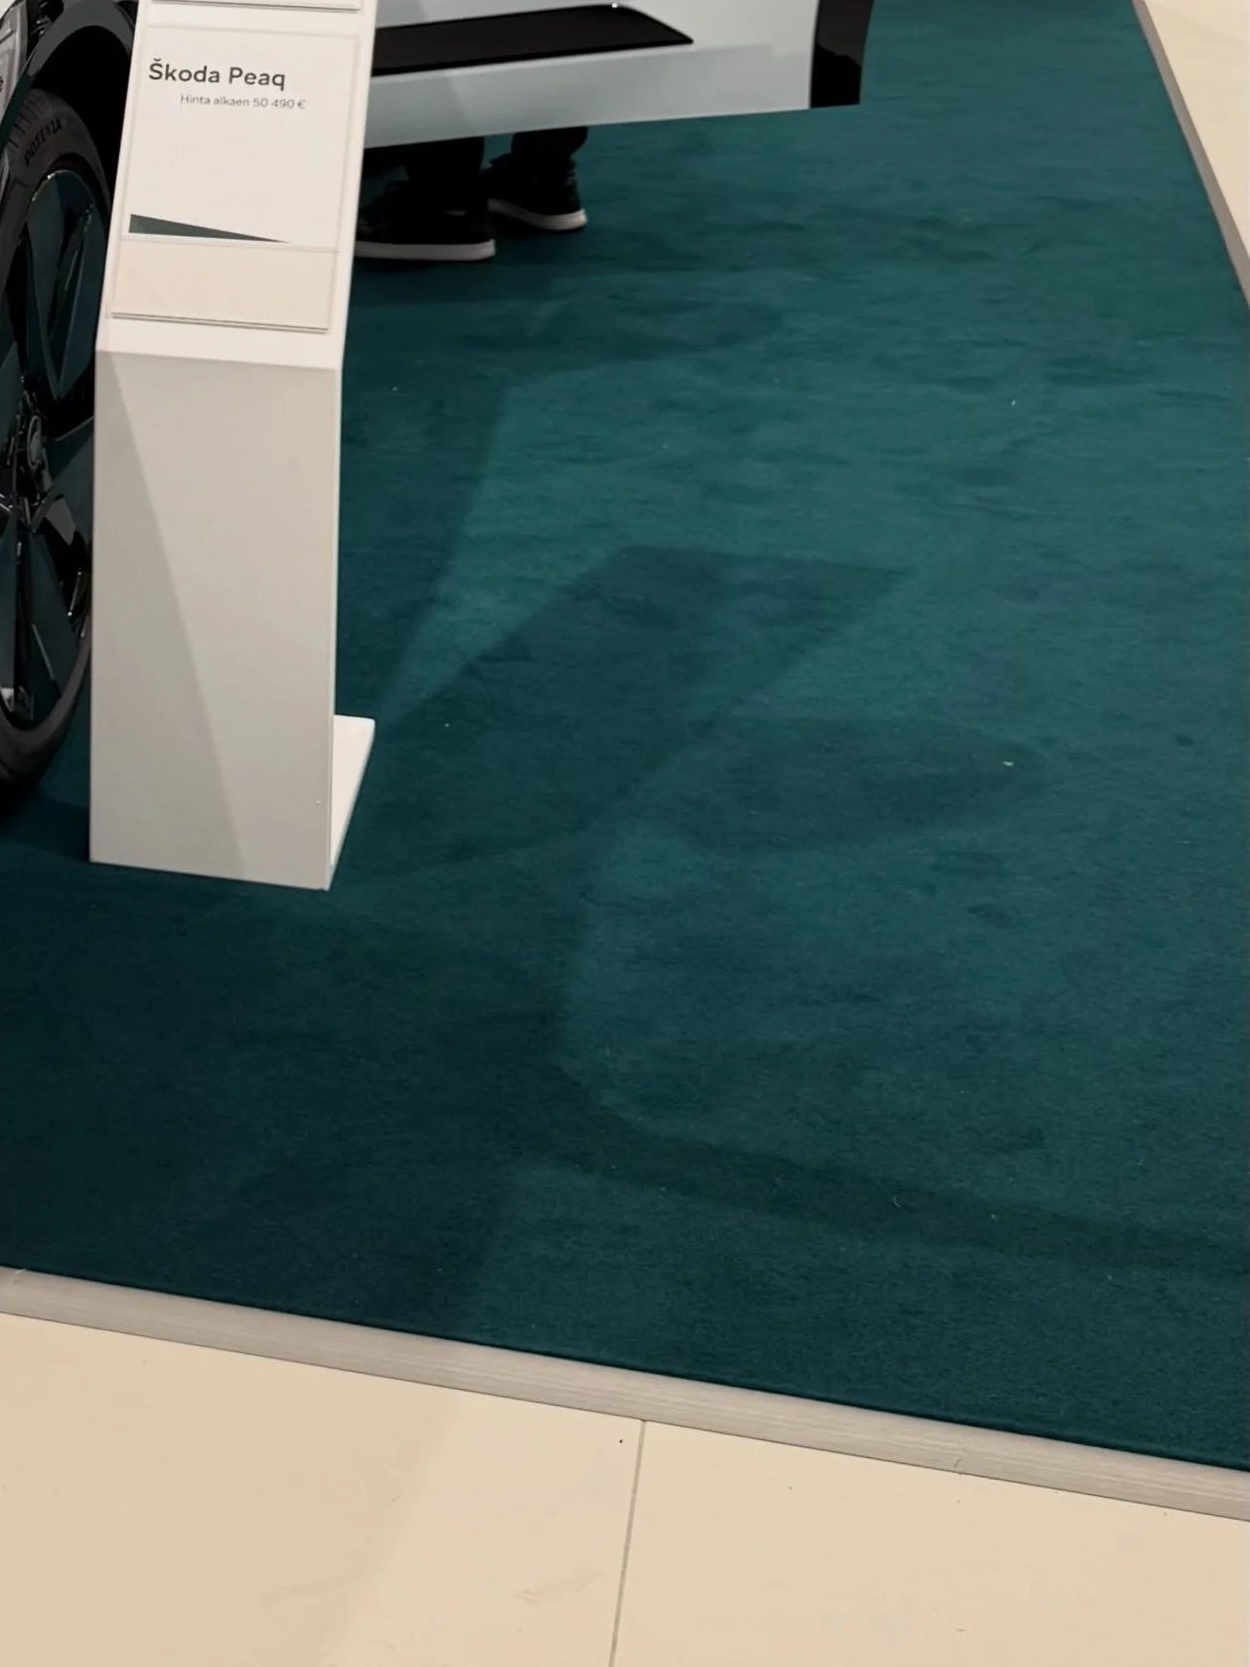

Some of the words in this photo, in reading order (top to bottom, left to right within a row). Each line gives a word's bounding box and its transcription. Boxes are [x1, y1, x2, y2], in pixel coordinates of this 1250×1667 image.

[148, 58, 220, 83] Škoda
[228, 66, 286, 91] Peaq
[180, 94, 211, 105] Hinta
[213, 95, 250, 107] alkaen
[253, 98, 269, 108] 50
[271, 98, 295, 109] 490
[297, 99, 306, 110] €
